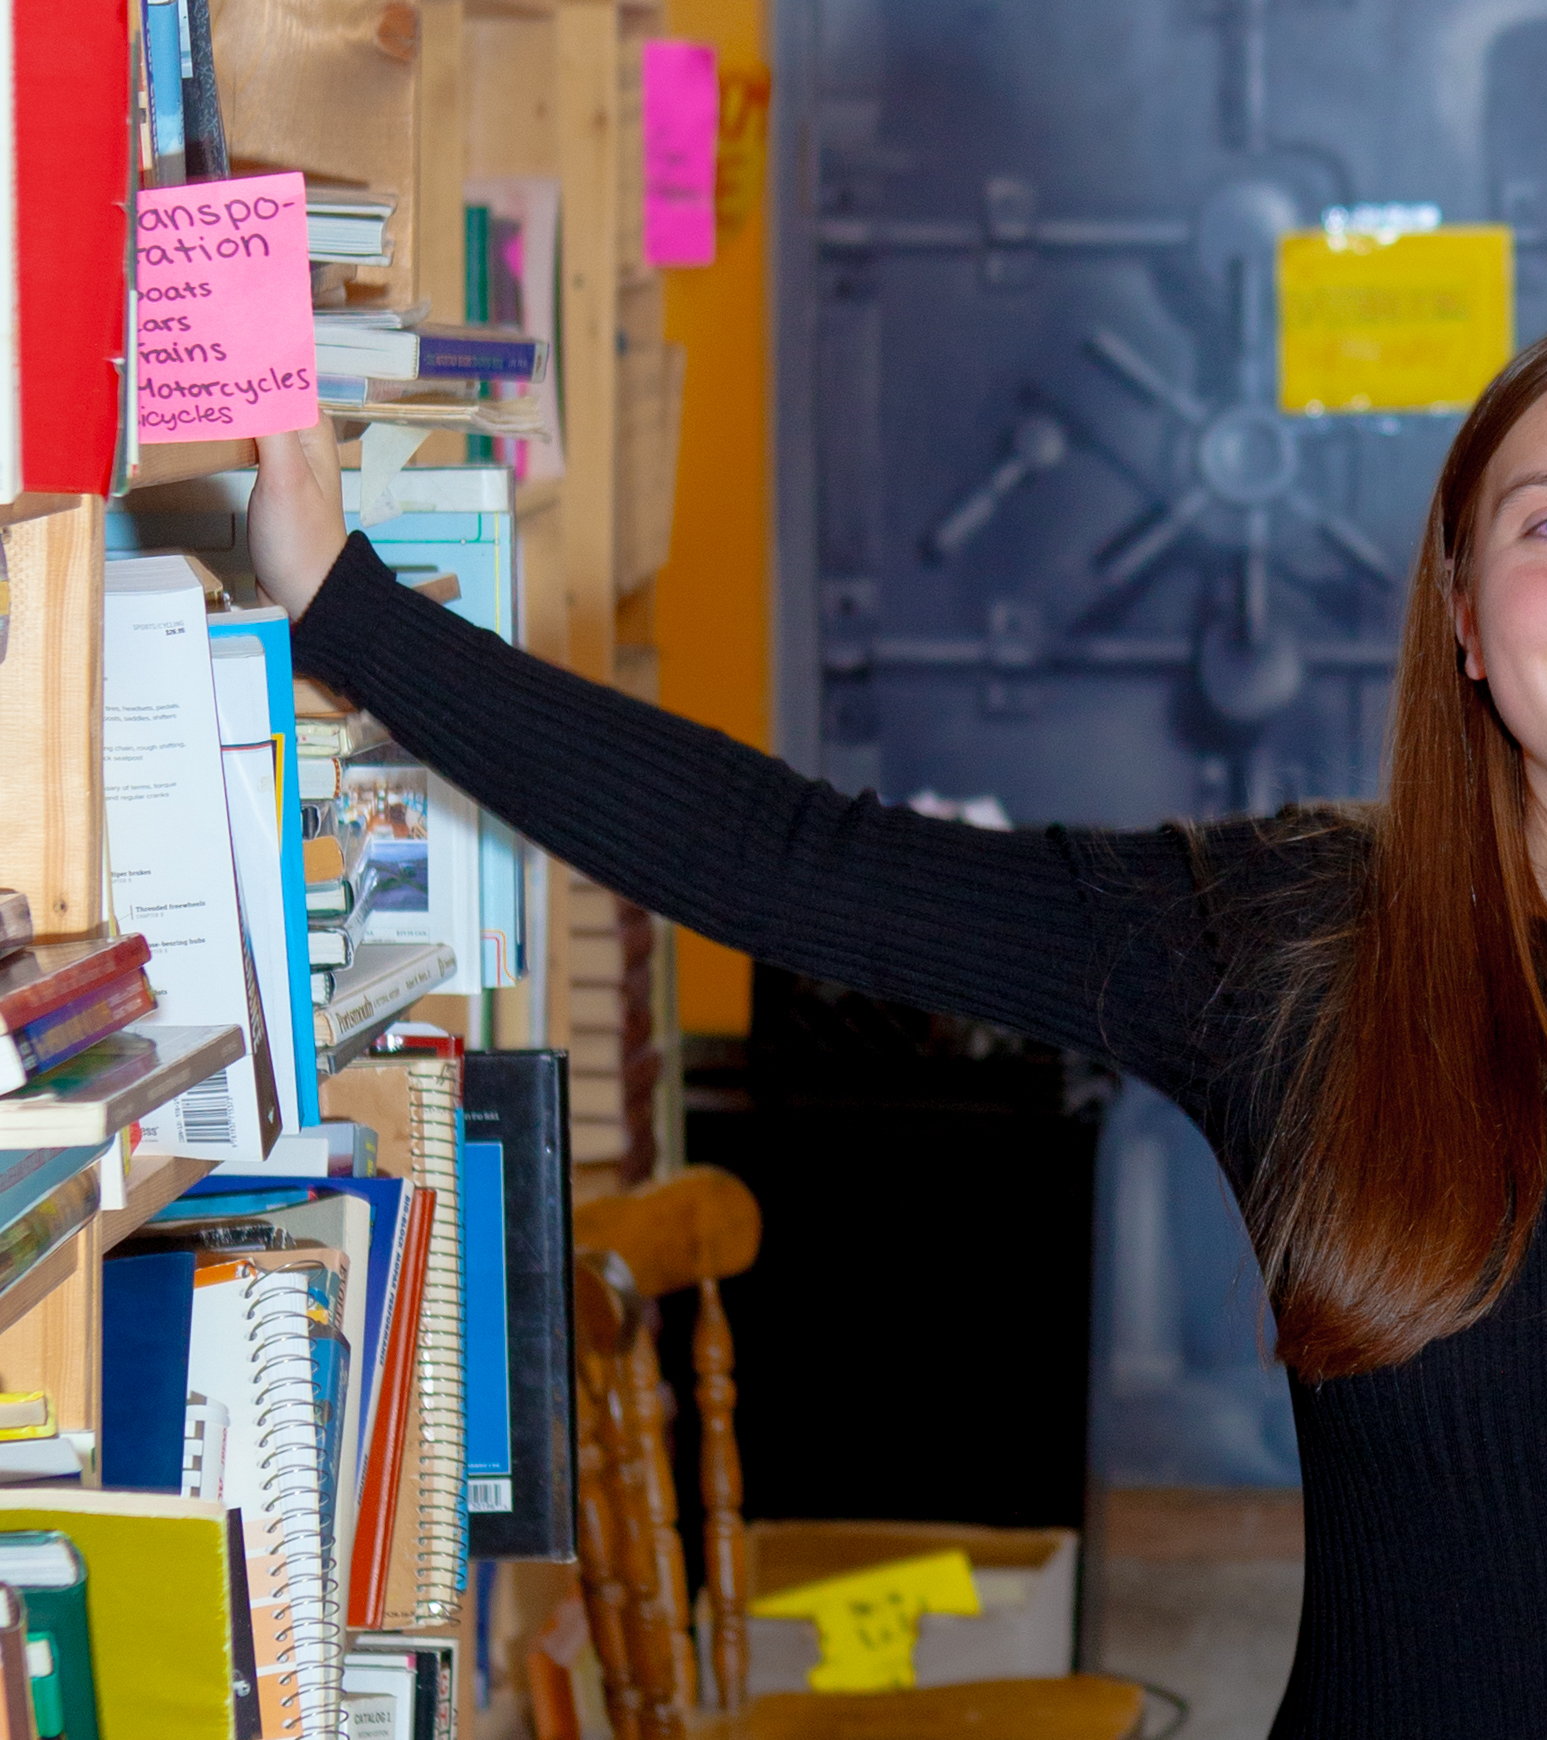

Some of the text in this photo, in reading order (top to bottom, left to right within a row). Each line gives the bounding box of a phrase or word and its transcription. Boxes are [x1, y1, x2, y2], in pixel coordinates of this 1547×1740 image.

[137, 315, 192, 332] ars
[138, 404, 234, 431] icycles
[334, 994, 375, 1035] Portsmouth
[395, 1194, 411, 1250] BIG-BLOCK
[389, 1251, 402, 1289] MOPAR
[378, 1291, 397, 1367] PERFORMANCE
[354, 1710, 387, 1725] CATALOG
